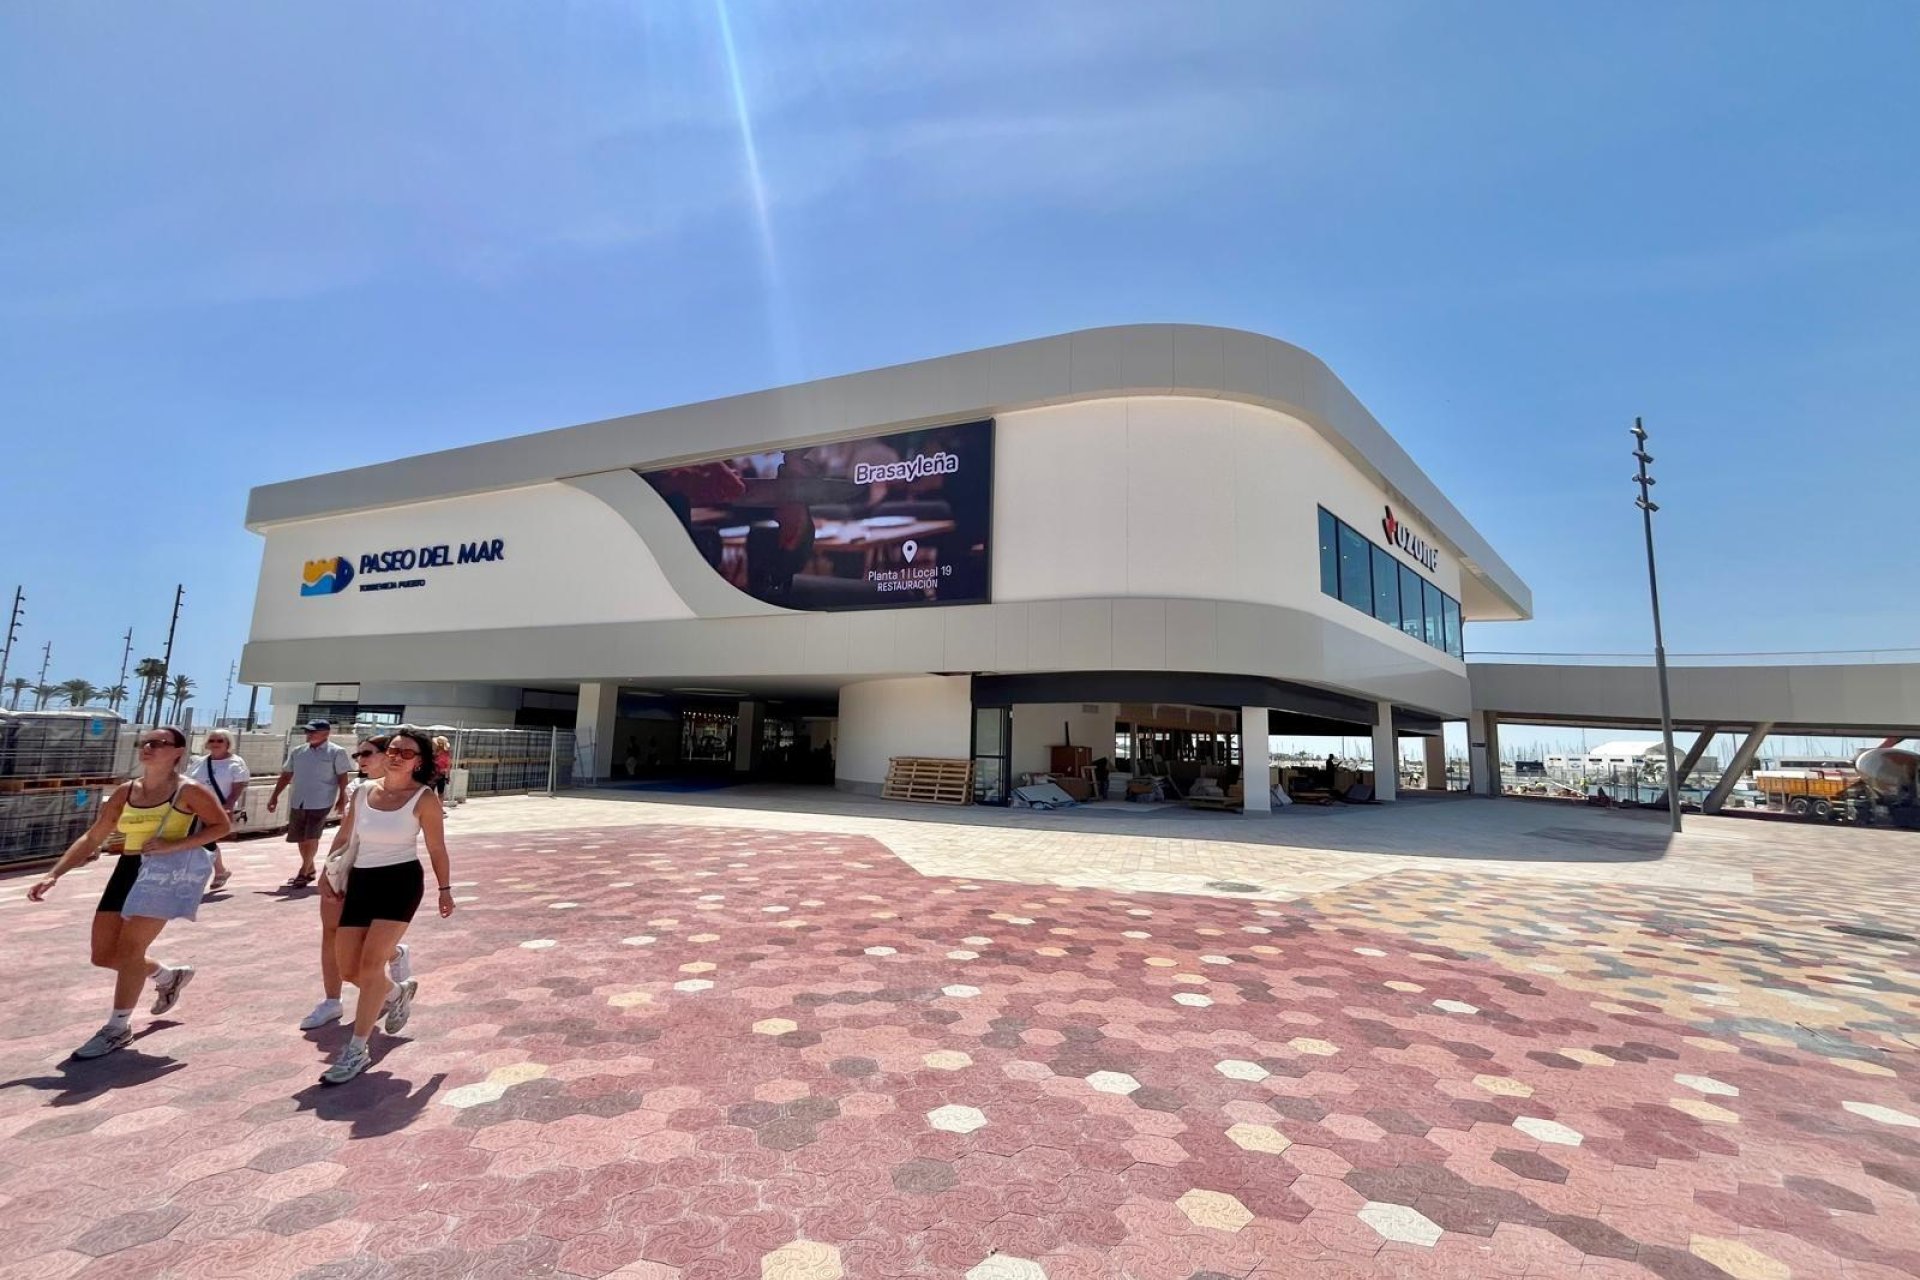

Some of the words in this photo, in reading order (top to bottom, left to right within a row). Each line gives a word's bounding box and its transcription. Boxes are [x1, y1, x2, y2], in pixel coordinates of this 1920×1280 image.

[855, 453, 958, 483] Brasayleña
[359, 549, 416, 574] PASEO
[418, 545, 454, 568] DEL
[457, 539, 504, 564] MAR
[868, 570, 898, 581] Planta
[900, 569, 905, 579] 1
[913, 567, 938, 578] Local
[940, 565, 952, 576] 19
[877, 578, 938, 592] RESTAURACIÓN
